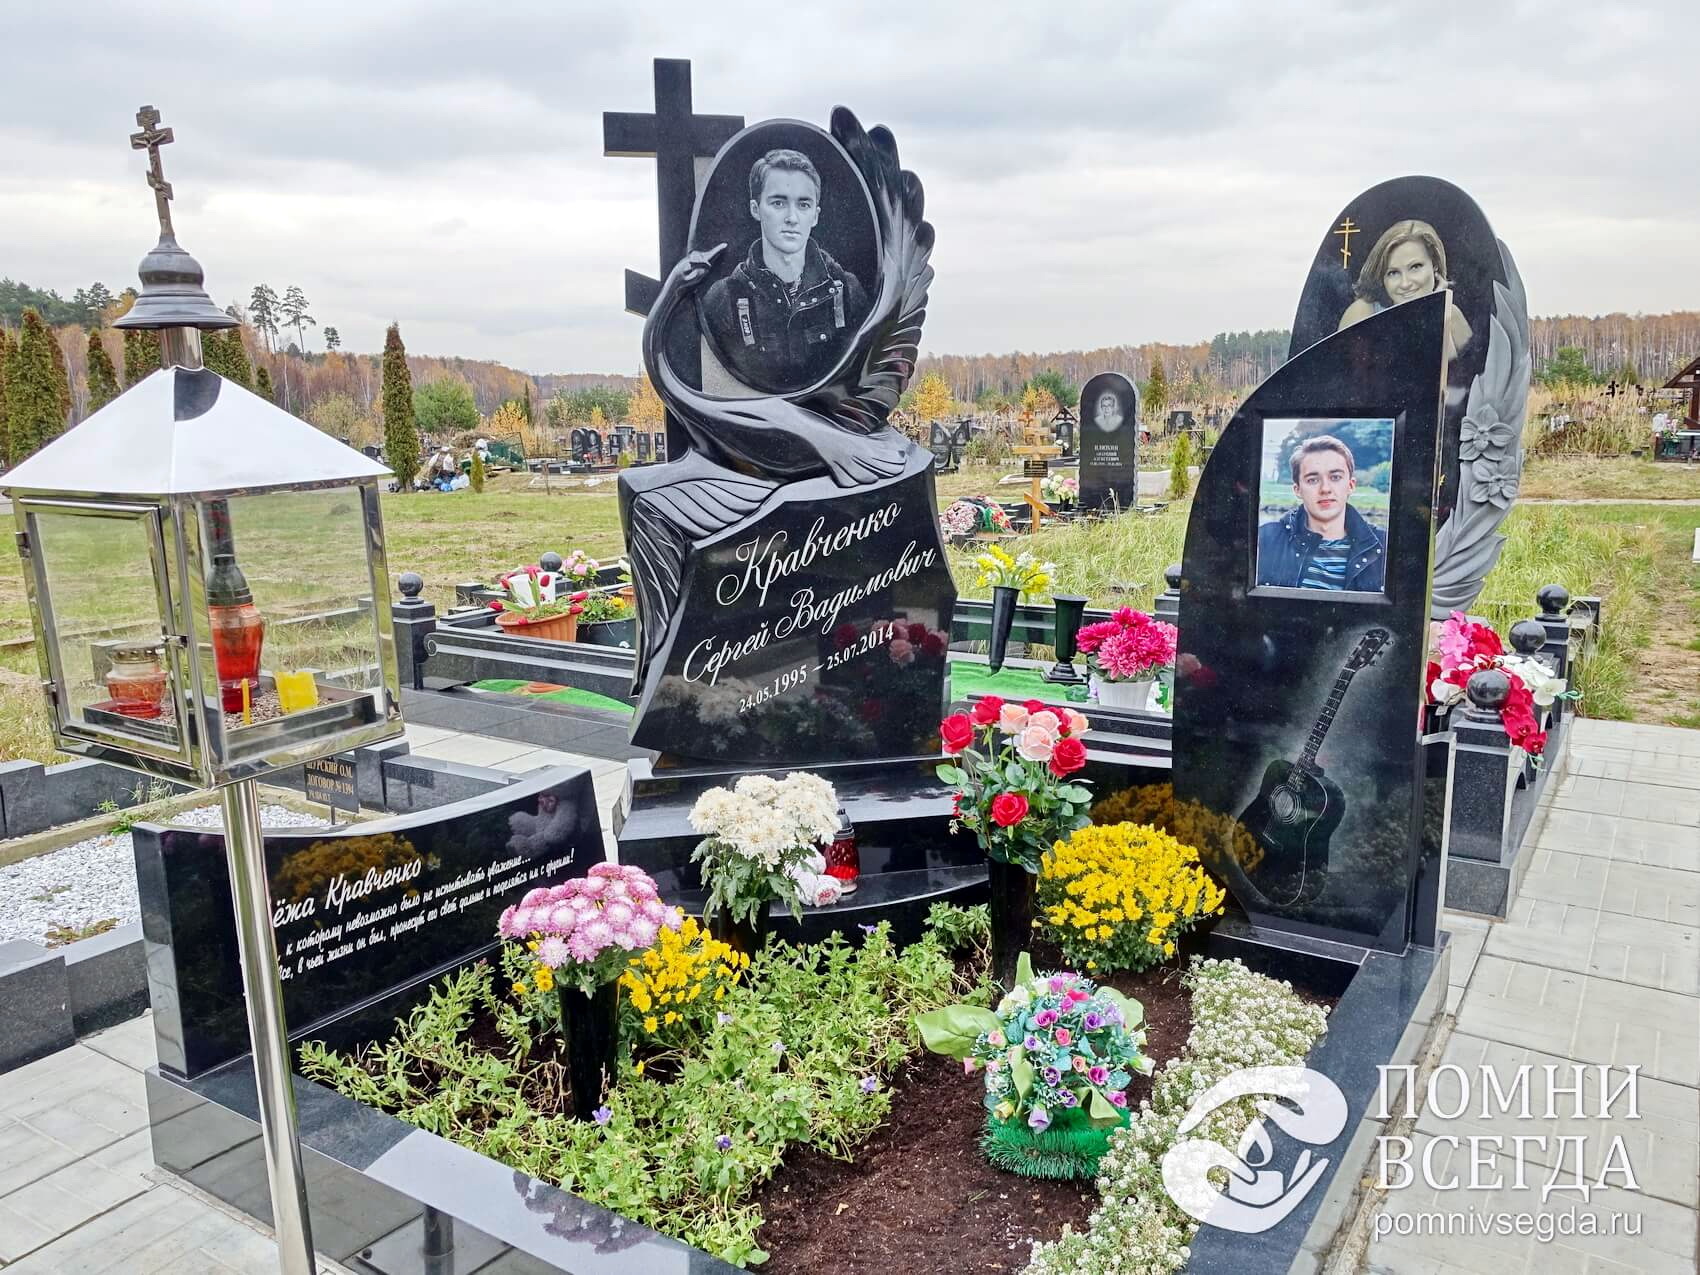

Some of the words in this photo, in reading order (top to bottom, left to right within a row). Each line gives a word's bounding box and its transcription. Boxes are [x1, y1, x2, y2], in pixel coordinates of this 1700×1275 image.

[716, 502, 902, 607] Кравченко
[683, 622, 772, 687] Сергей
[774, 539, 937, 638] Вадимович
[739, 665, 808, 713] 24.05.1995
[827, 624, 895, 670] 25.07.2014
[307, 773, 334, 791] ДОГОВОР
[273, 897, 316, 928] ёжа
[325, 858, 422, 916] Кравченко
[286, 943, 293, 955] к
[296, 924, 343, 952] которому
[346, 903, 398, 933] невозможно
[400, 893, 421, 912] было
[423, 890, 434, 903] не
[435, 867, 485, 898] испытывать
[297, 956, 305, 974] в
[306, 948, 324, 971] чьей
[327, 942, 354, 963] жизни
[356, 937, 367, 951] он
[369, 927, 387, 945] был,
[390, 910, 425, 941] пронесут
[427, 908, 437, 922] его
[440, 897, 457, 916] свет
[459, 889, 485, 913] дальше
[486, 887, 491, 898] и
[493, 872, 527, 896] поделятся
[529, 868, 539, 880] им
[540, 865, 545, 875] с
[546, 847, 576, 877] другими!
